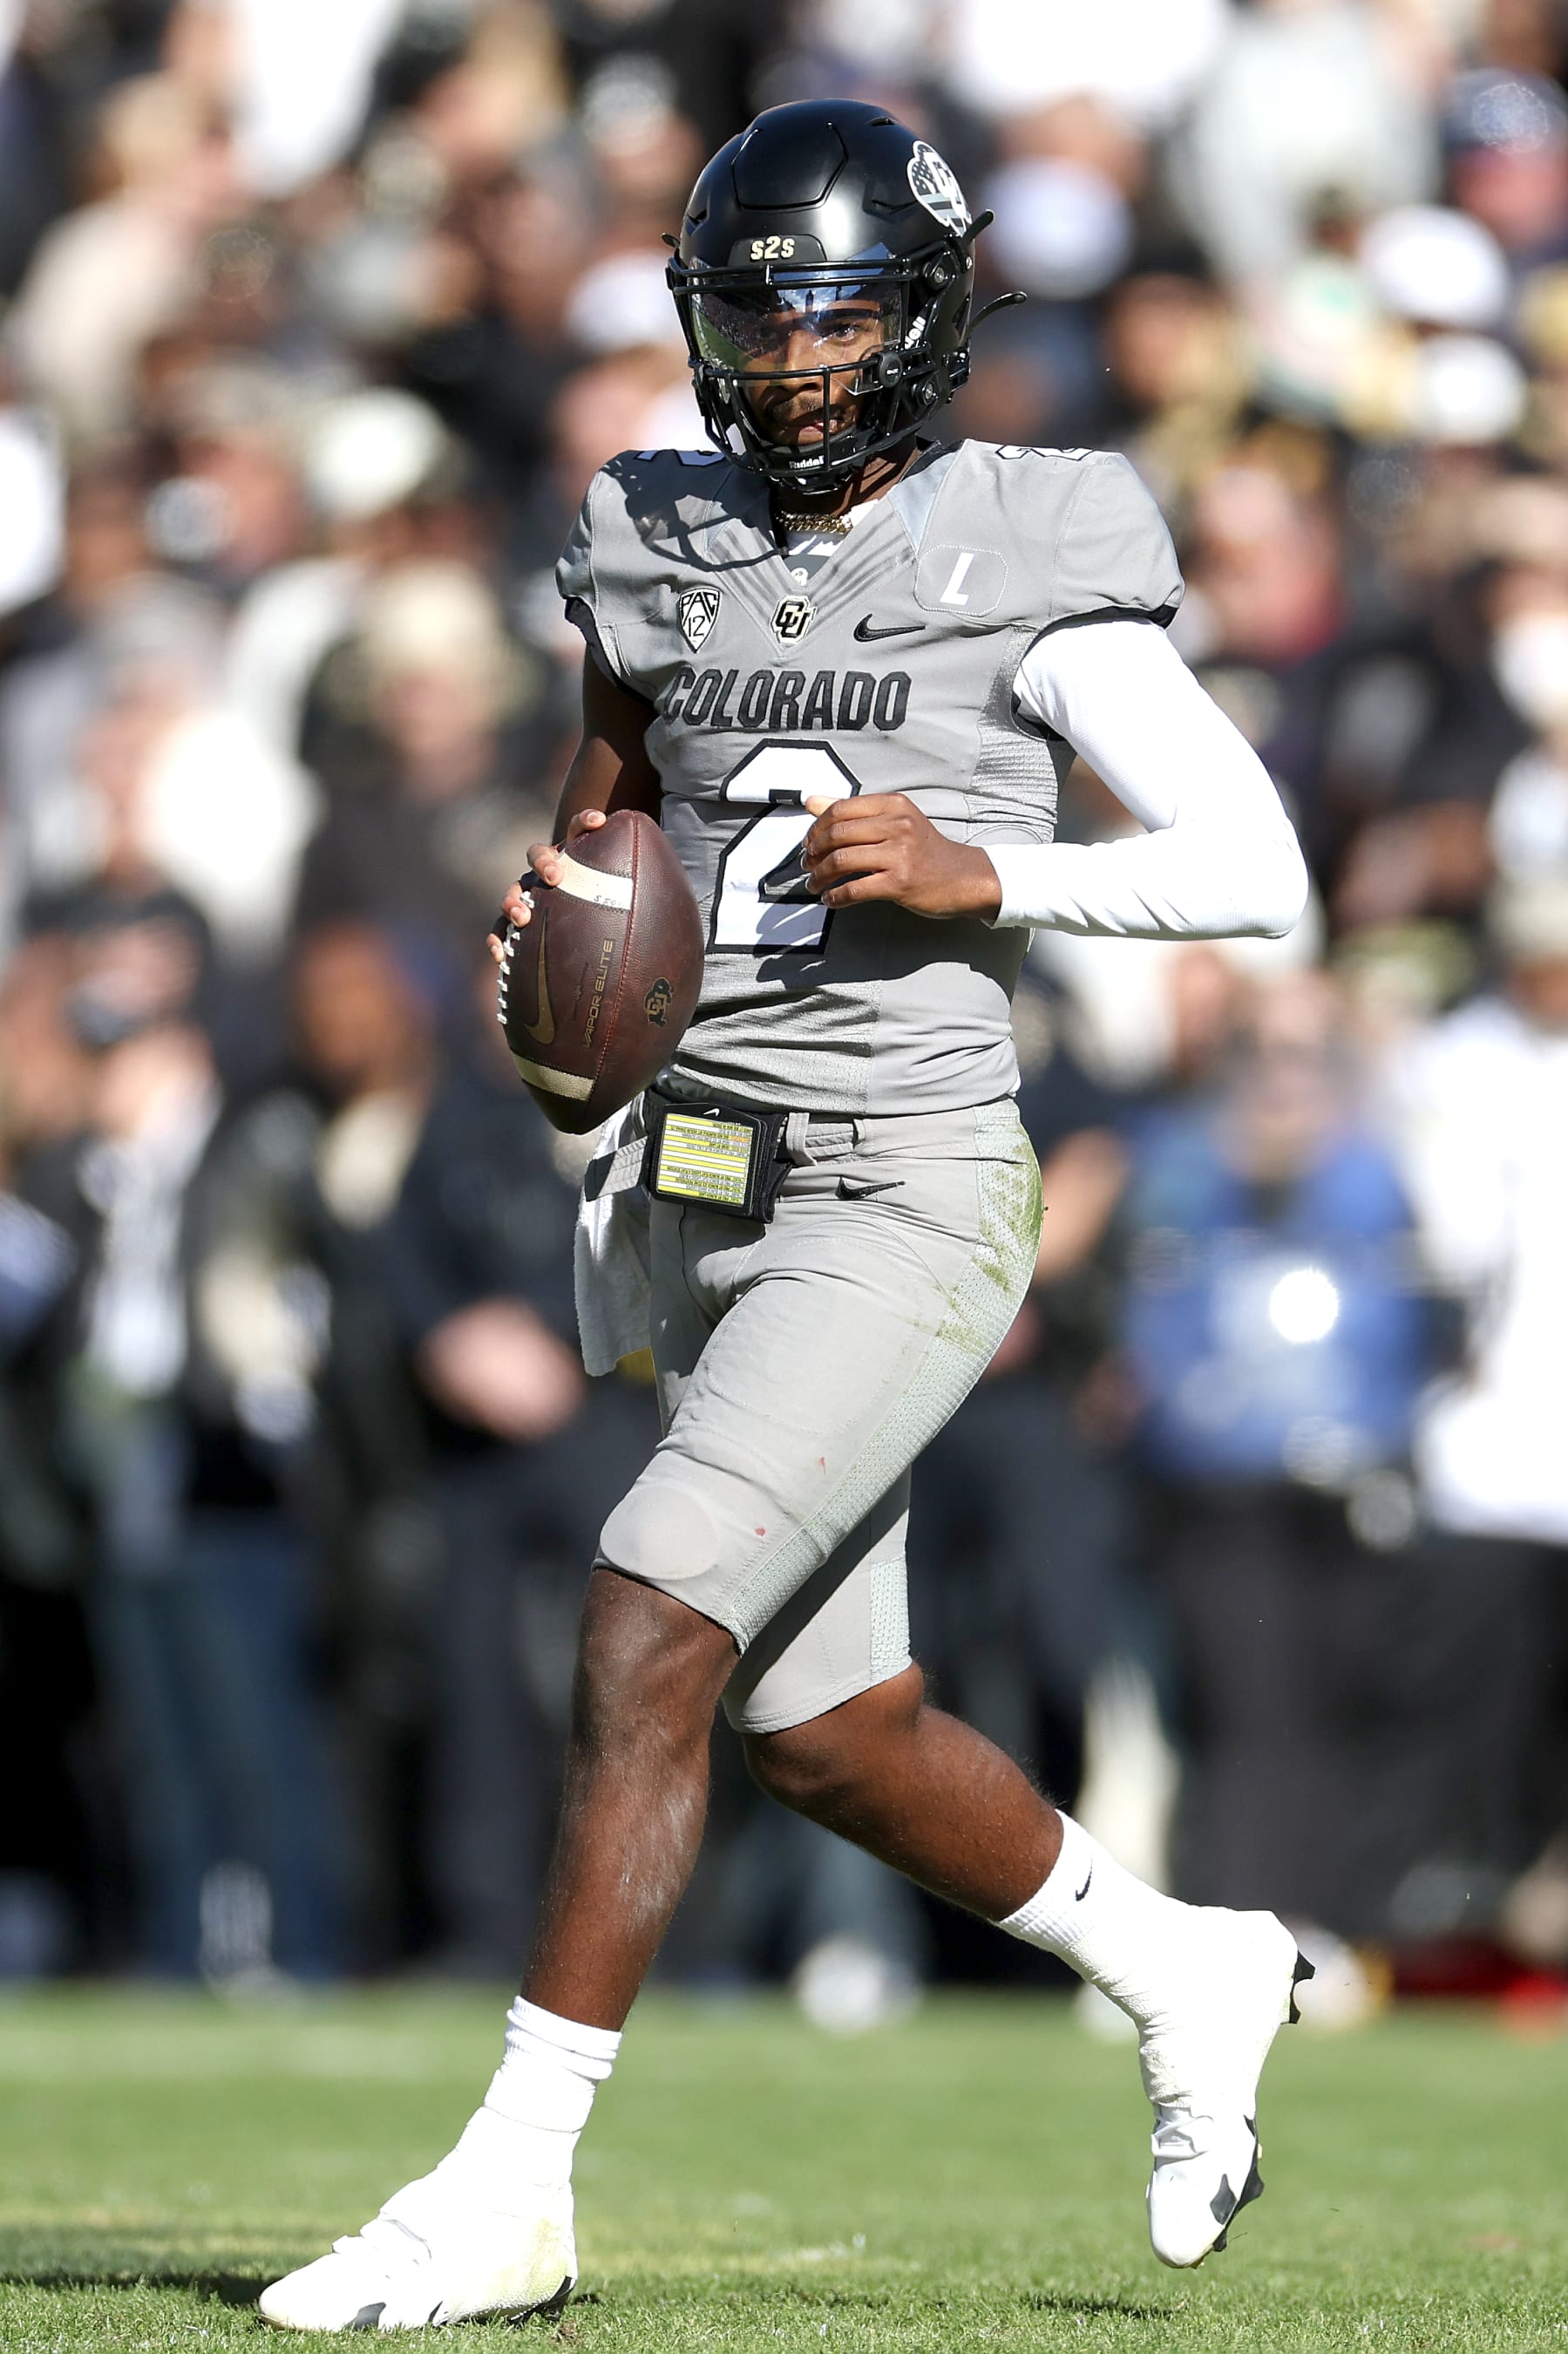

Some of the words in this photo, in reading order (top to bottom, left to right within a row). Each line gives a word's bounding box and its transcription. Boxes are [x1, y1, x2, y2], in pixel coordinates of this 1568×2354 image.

[681, 590, 720, 626] PAC
[939, 552, 974, 606] L
[687, 615, 706, 638] 12
[662, 666, 912, 731] COLORADO
[706, 738, 862, 955] 2
[581, 995, 601, 1049] VAPOR
[594, 940, 614, 992] ELITE
